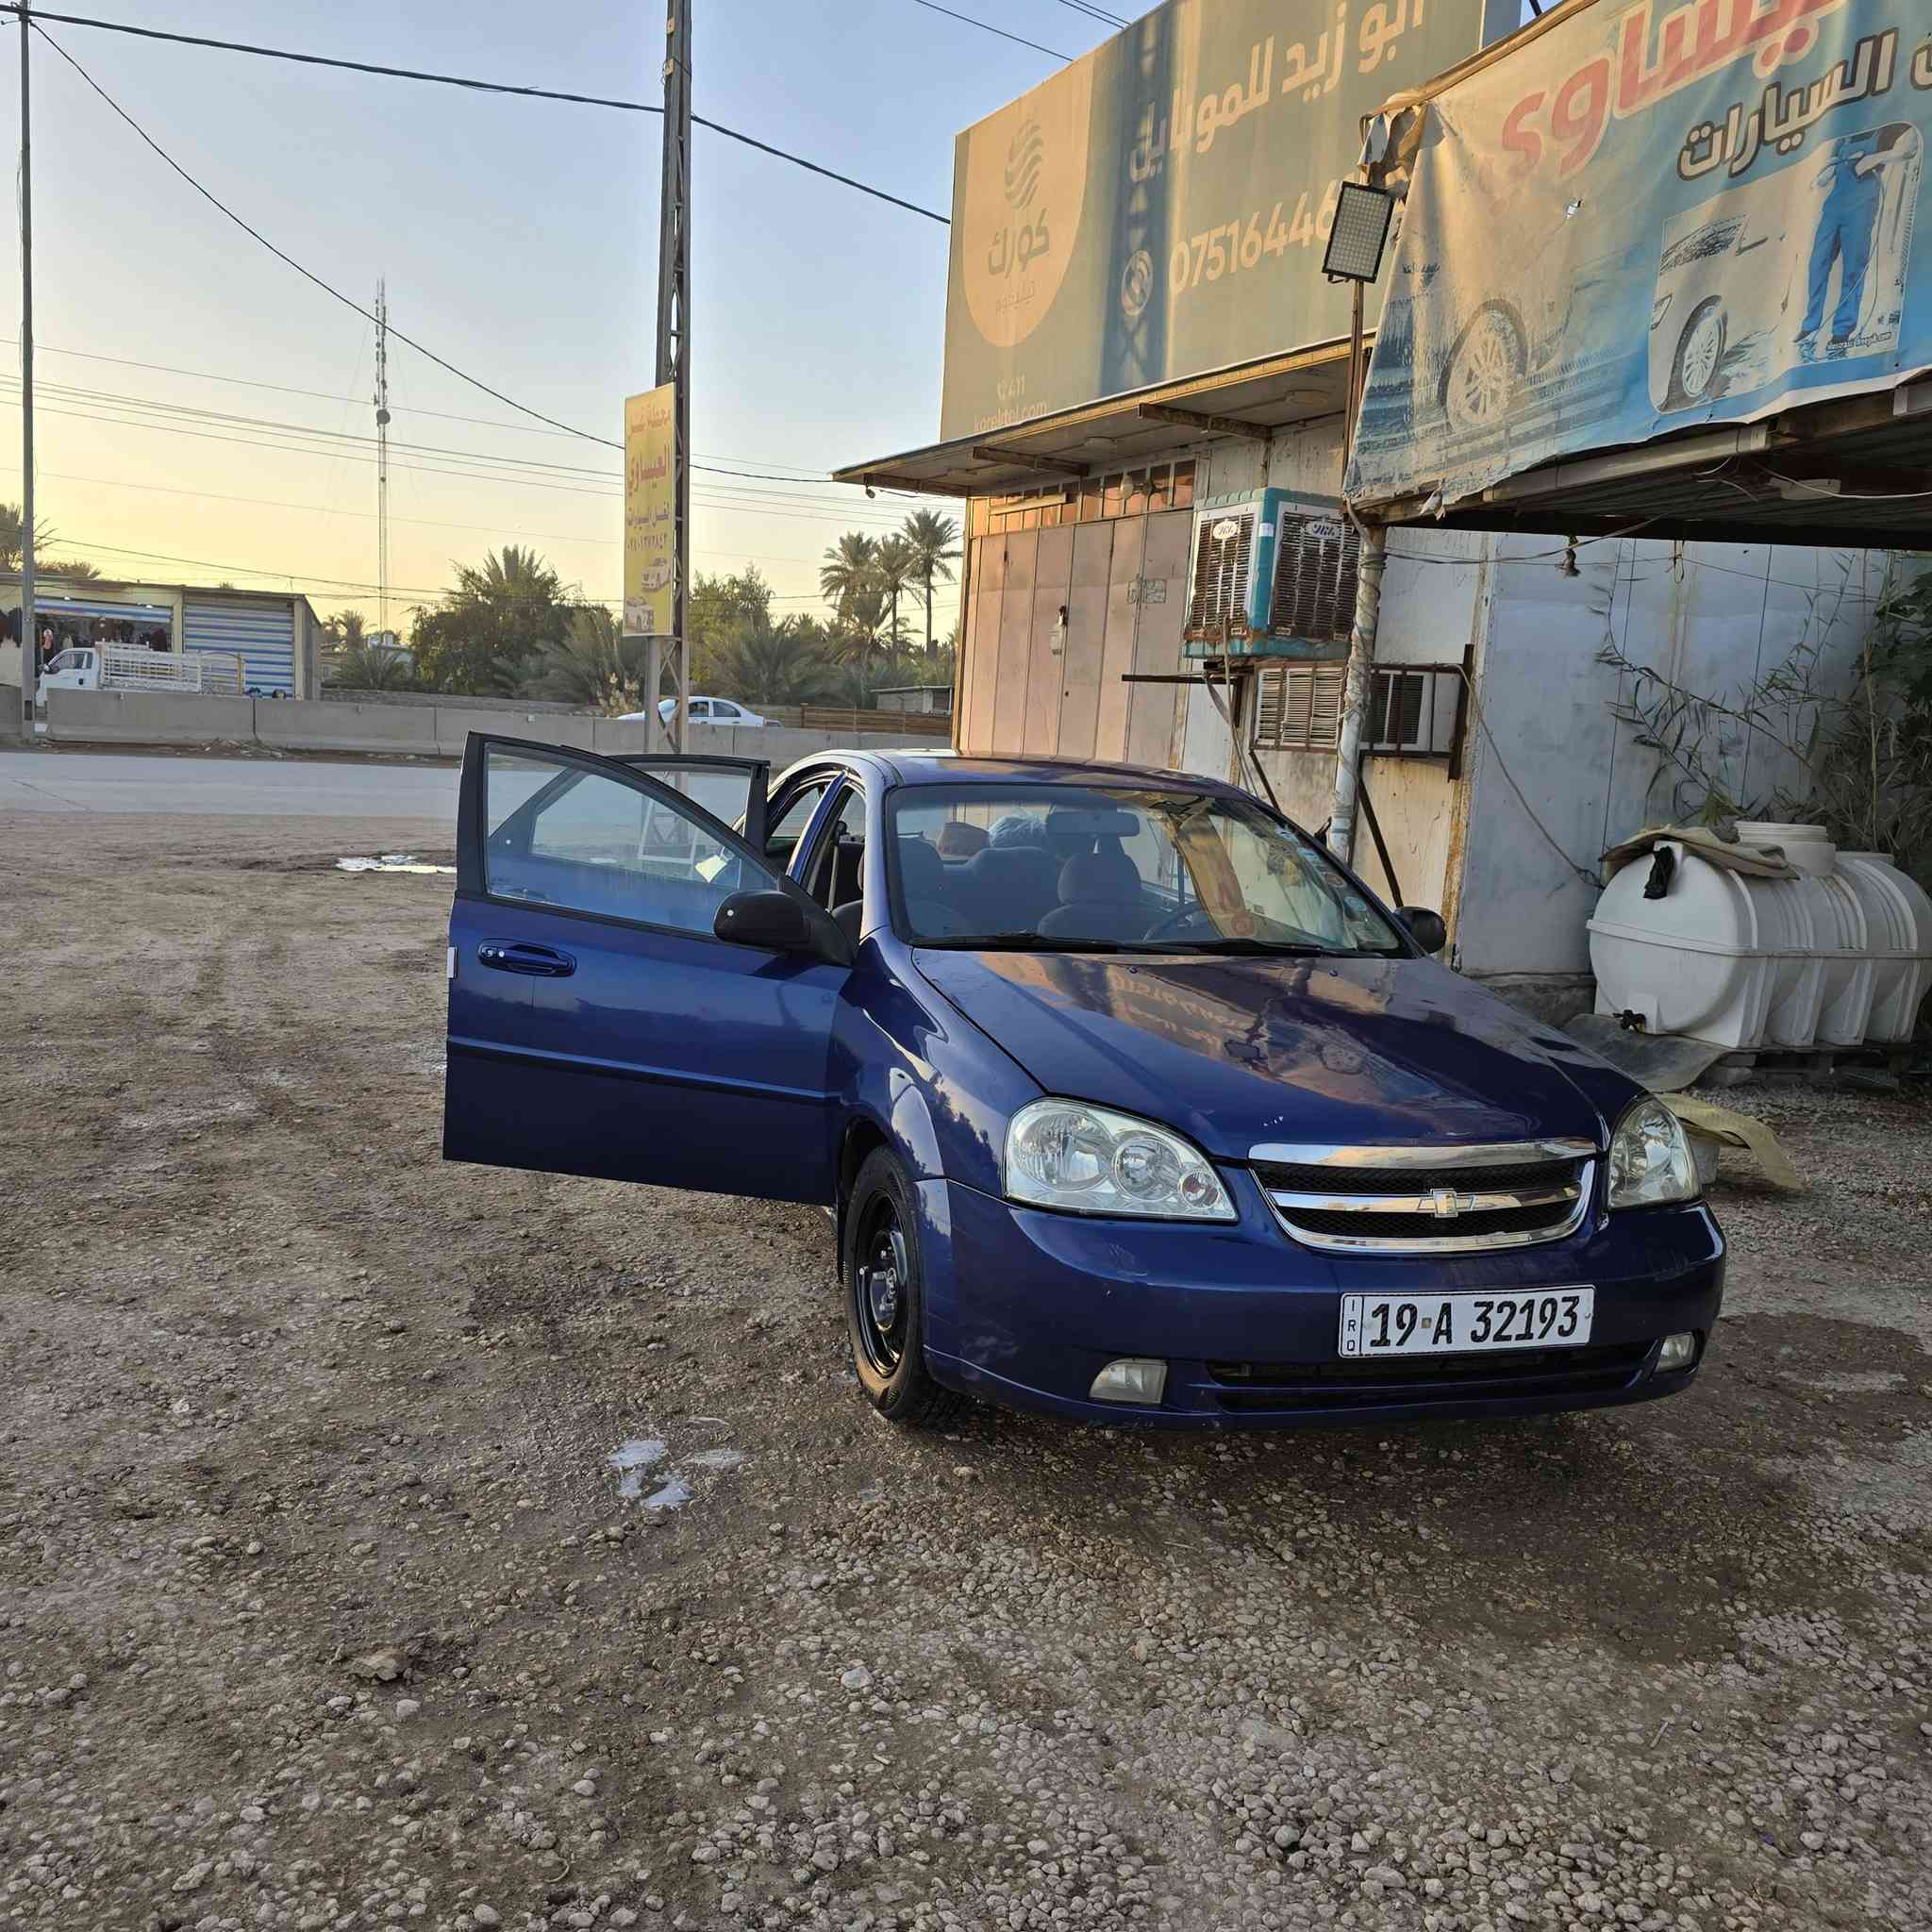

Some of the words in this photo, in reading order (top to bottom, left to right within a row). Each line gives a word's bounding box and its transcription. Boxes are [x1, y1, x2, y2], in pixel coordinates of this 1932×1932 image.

[1281, 2, 1346, 104] زيد
[1676, 28, 1899, 180] السيارات
[1170, 174, 1356, 295] 07516446
[1370, 1303, 1418, 1347] 19
[1432, 1302, 1453, 1345] A
[1470, 1295, 1580, 1343] 32193
